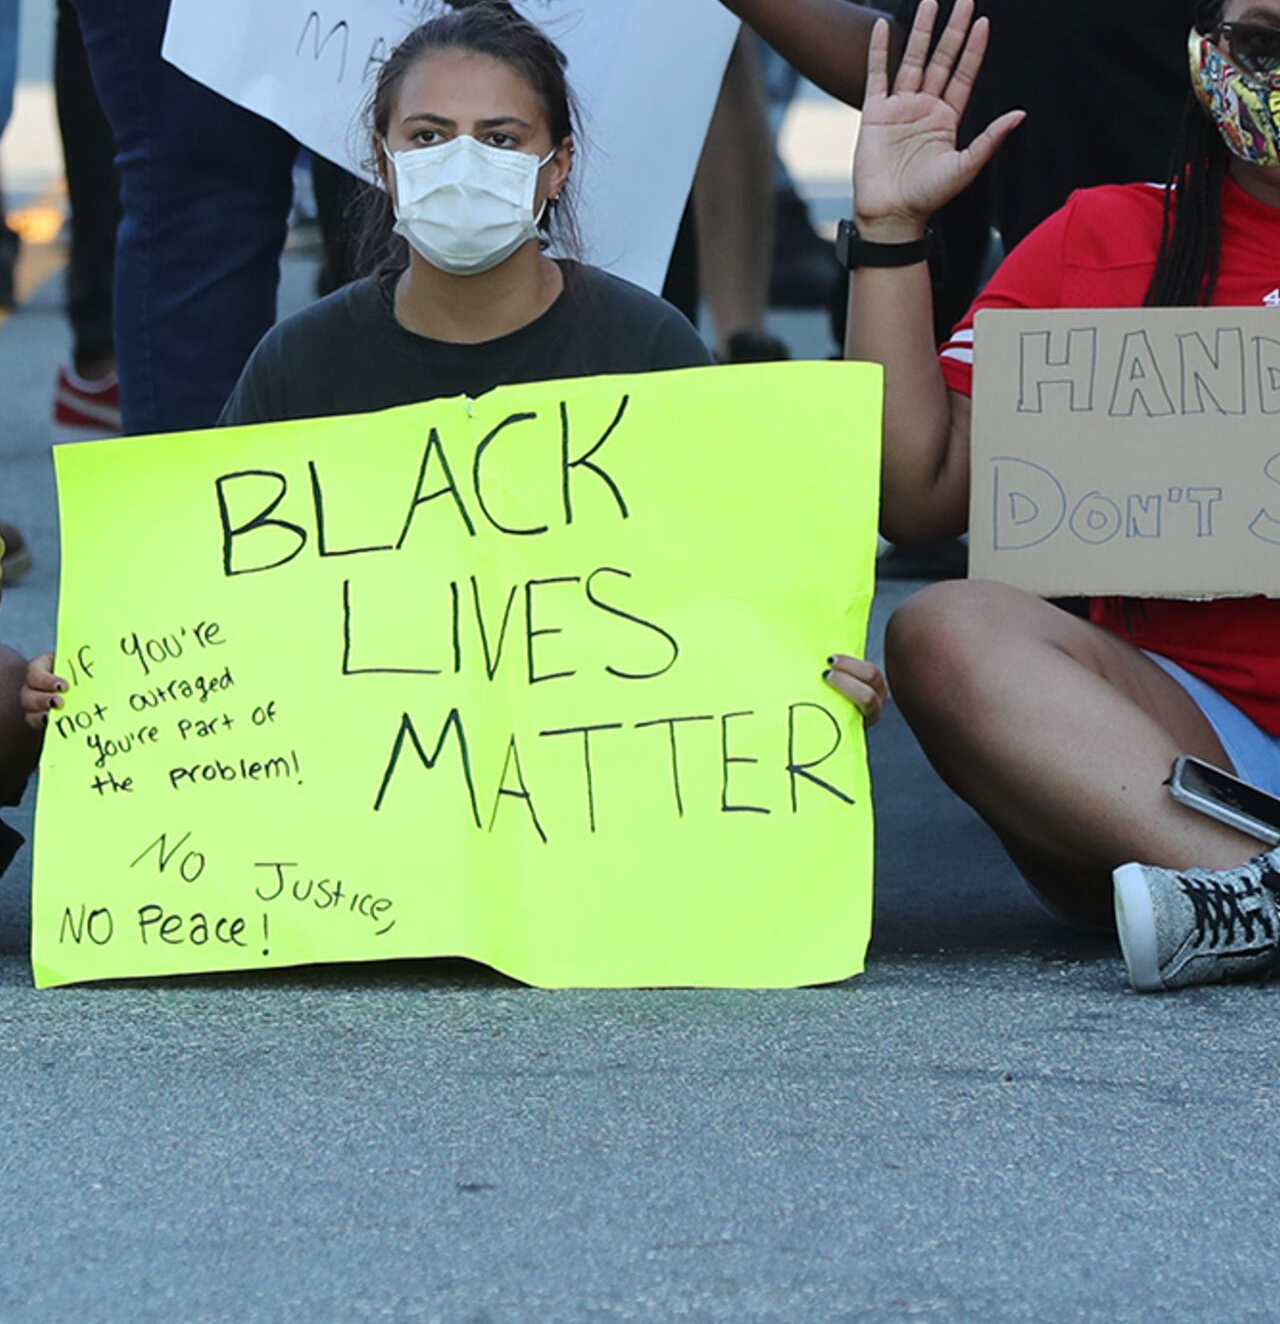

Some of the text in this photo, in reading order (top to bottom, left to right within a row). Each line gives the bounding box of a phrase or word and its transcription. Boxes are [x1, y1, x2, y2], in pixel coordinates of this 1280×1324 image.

[216, 395, 631, 577] BLACK
[343, 568, 680, 684] LIVES
[55, 667, 235, 739] not outraged
[90, 774, 135, 797] the
[374, 702, 856, 843] MATTER
